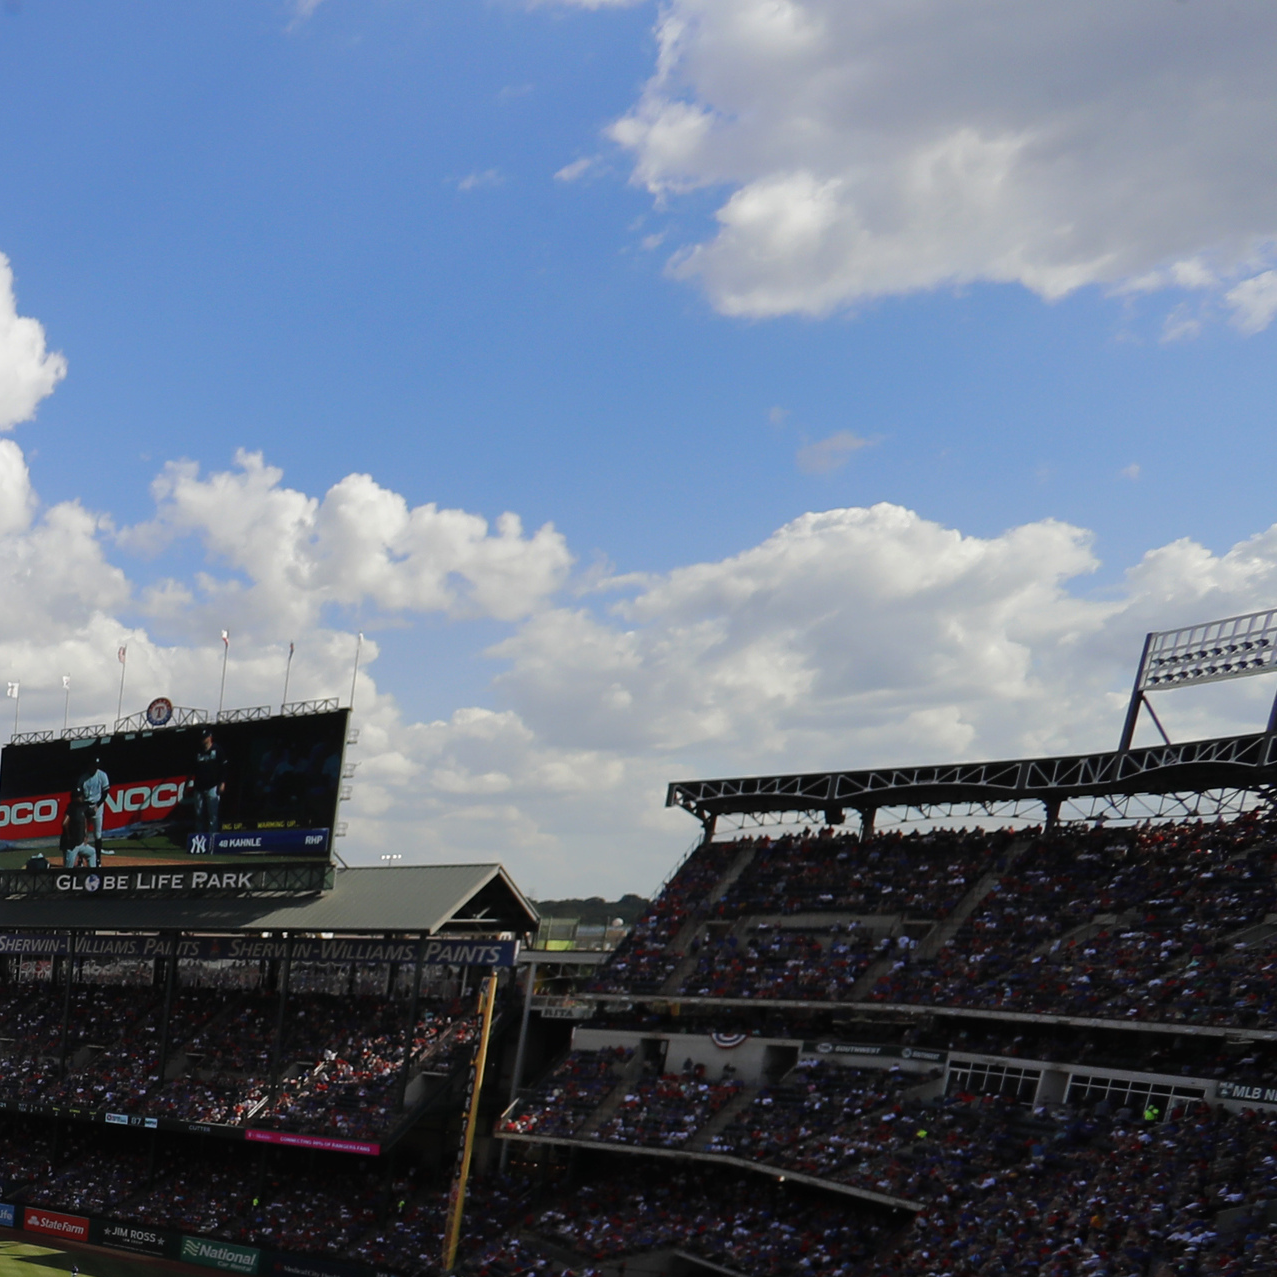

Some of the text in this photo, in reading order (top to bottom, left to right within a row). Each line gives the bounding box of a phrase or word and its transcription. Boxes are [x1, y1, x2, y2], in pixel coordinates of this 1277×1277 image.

[230, 837, 262, 849] KAHNLE
[305, 835, 324, 846] RHP
[56, 871, 254, 893] GLOBE LIFE PARK
[423, 941, 500, 964] PAINTS
[1233, 1084, 1261, 1099] MLB
[131, 1116, 142, 1125] 87
[280, 1136, 310, 1145] CONNECTING
[332, 1142, 356, 1152] RANGERS
[357, 1145, 370, 1153] FANS
[111, 1226, 156, 1243] JIM ROSS
[199, 1243, 256, 1266] National
[217, 1260, 252, 1272] Car Rental
[284, 1264, 307, 1275] Medical
